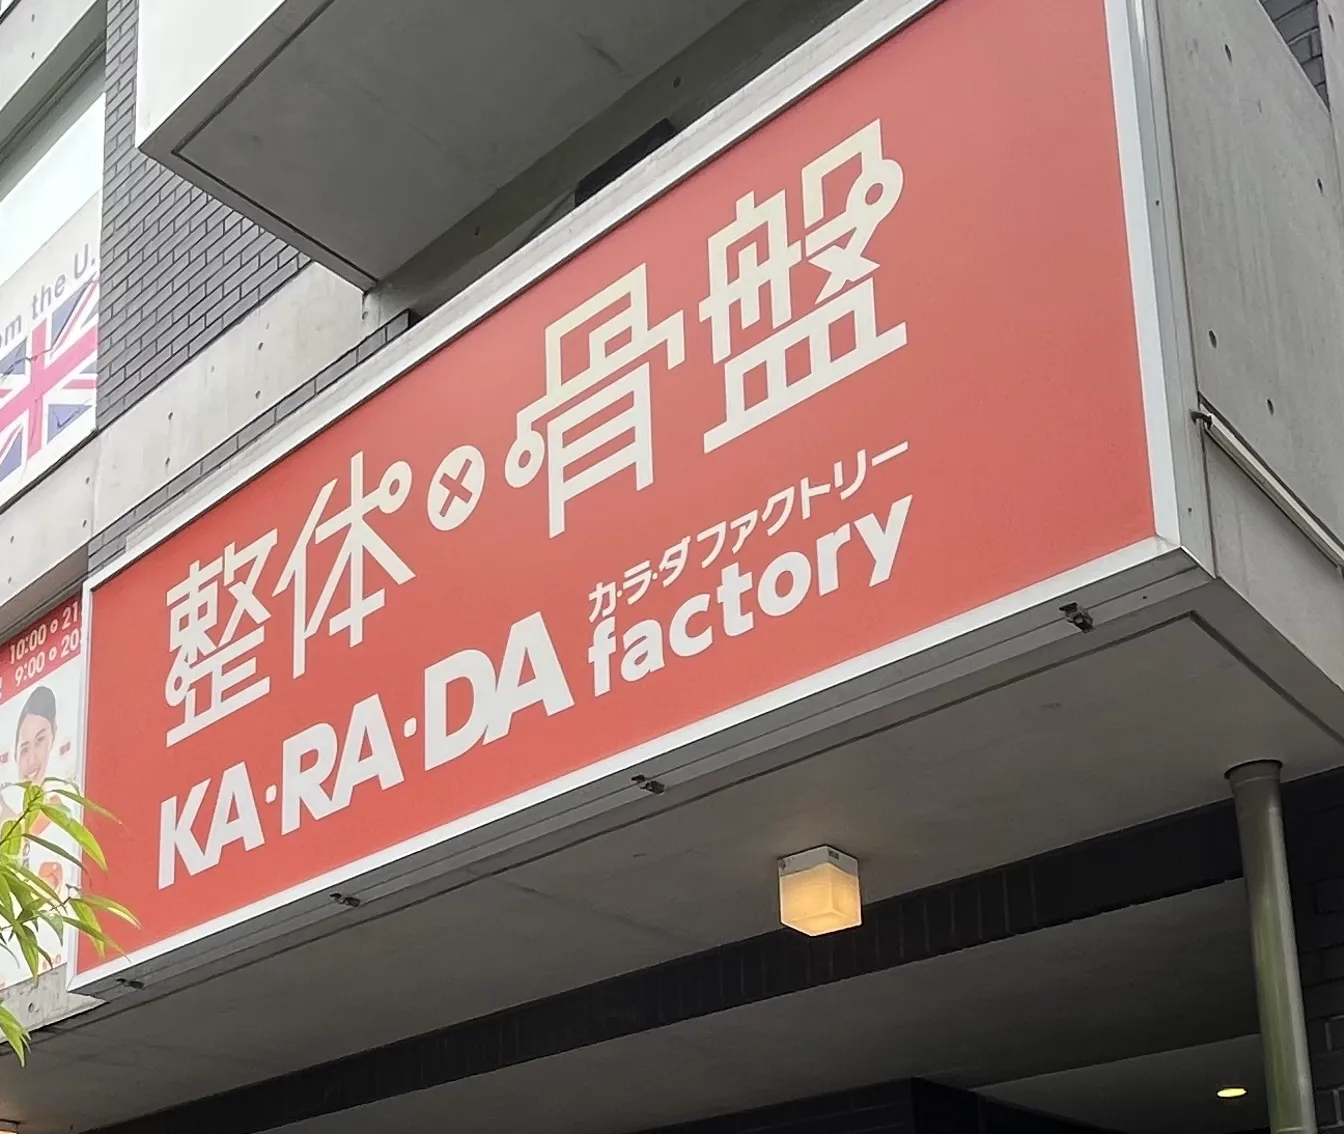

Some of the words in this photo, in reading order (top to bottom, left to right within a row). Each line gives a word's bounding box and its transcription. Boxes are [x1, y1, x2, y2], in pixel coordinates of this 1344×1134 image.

[32, 274, 66, 320] the
[588, 494, 913, 697] factory
[10, 624, 47, 665] 10:00
[14, 651, 46, 687] 9:00
